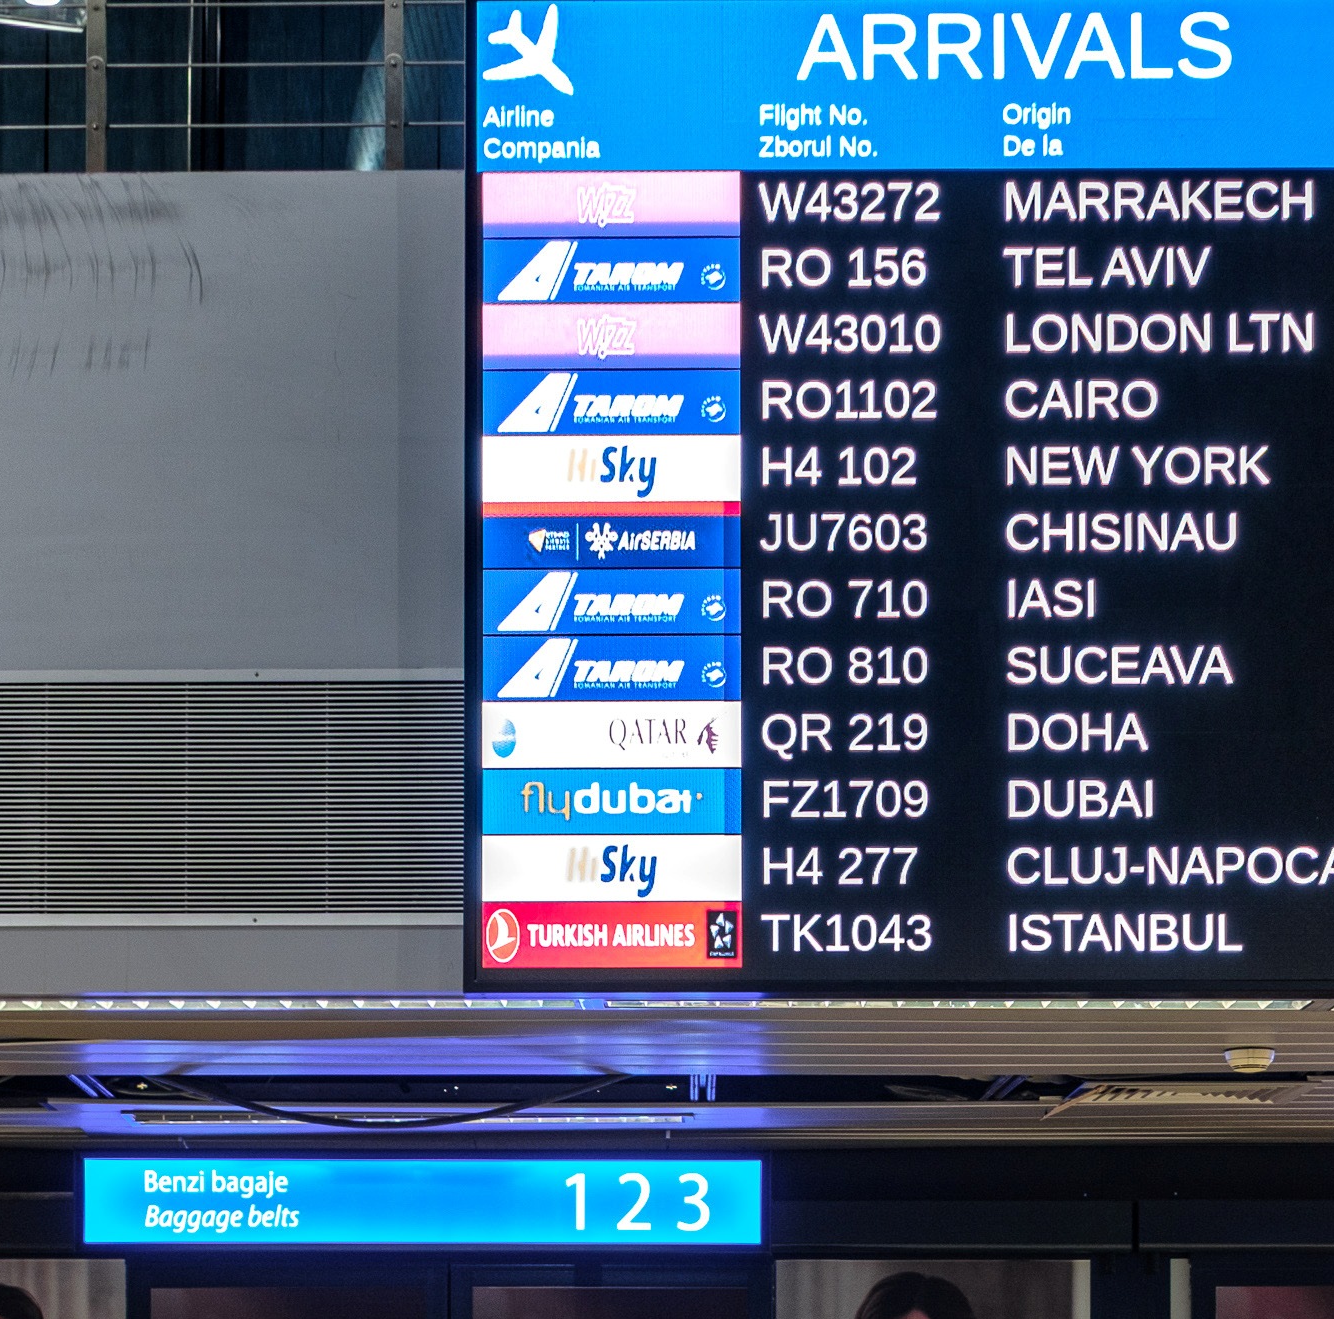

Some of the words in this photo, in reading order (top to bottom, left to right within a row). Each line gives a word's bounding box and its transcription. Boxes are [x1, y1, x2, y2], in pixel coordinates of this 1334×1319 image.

[797, 12, 1234, 82] ARRIVALS
[483, 106, 556, 129] Airline
[759, 104, 823, 132] Flight
[830, 104, 869, 127] No.
[1003, 103, 1072, 131] Origin
[484, 137, 602, 165] Compania
[759, 136, 833, 159] Zborul
[840, 136, 879, 159] No.
[1004, 135, 1037, 158] De
[1043, 134, 1064, 158] la
[758, 182, 942, 224] W43272
[1005, 181, 1315, 223] MARRAKECH
[762, 248, 833, 289] RO
[848, 247, 928, 289] 156
[1003, 246, 1094, 289] TEL
[1102, 246, 1212, 289] AVIV
[759, 314, 943, 356] W43010
[1006, 313, 1212, 355] LONDON
[1229, 313, 1316, 354] LTN
[762, 380, 939, 421] RO1102
[1004, 380, 1160, 421] CAIRO
[763, 447, 824, 488] H4
[839, 447, 918, 488] 102
[1006, 446, 1121, 487] NEW
[1132, 446, 1271, 487] YORK
[760, 514, 929, 553] JU7603
[1005, 513, 1238, 554] CHISINAU
[763, 581, 833, 620] RO
[849, 580, 929, 620] 710
[1007, 579, 1096, 620] IASI
[763, 647, 834, 687] RO
[849, 647, 929, 686] 810
[1006, 646, 1235, 686] SUCEAVA
[609, 718, 687, 751] QATAR
[762, 714, 834, 762] QR
[849, 713, 929, 752] 219
[1008, 713, 1150, 753] DOHA
[763, 781, 930, 820] FZ1709
[1008, 780, 1155, 820] DUBAI
[763, 847, 825, 886] H4
[839, 847, 919, 886] 277
[527, 924, 608, 947] TURKISH
[613, 924, 695, 947] AIRLINES
[761, 914, 933, 953] TK1043
[1009, 914, 1244, 953] ISTANBUL
[144, 1170, 206, 1194] Benzi
[212, 1170, 289, 1200] bagaje
[566, 1173, 587, 1232] 1
[617, 1173, 653, 1232] 2
[677, 1173, 711, 1233] 3
[145, 1205, 242, 1234] Baggage
[248, 1205, 300, 1230] belts
